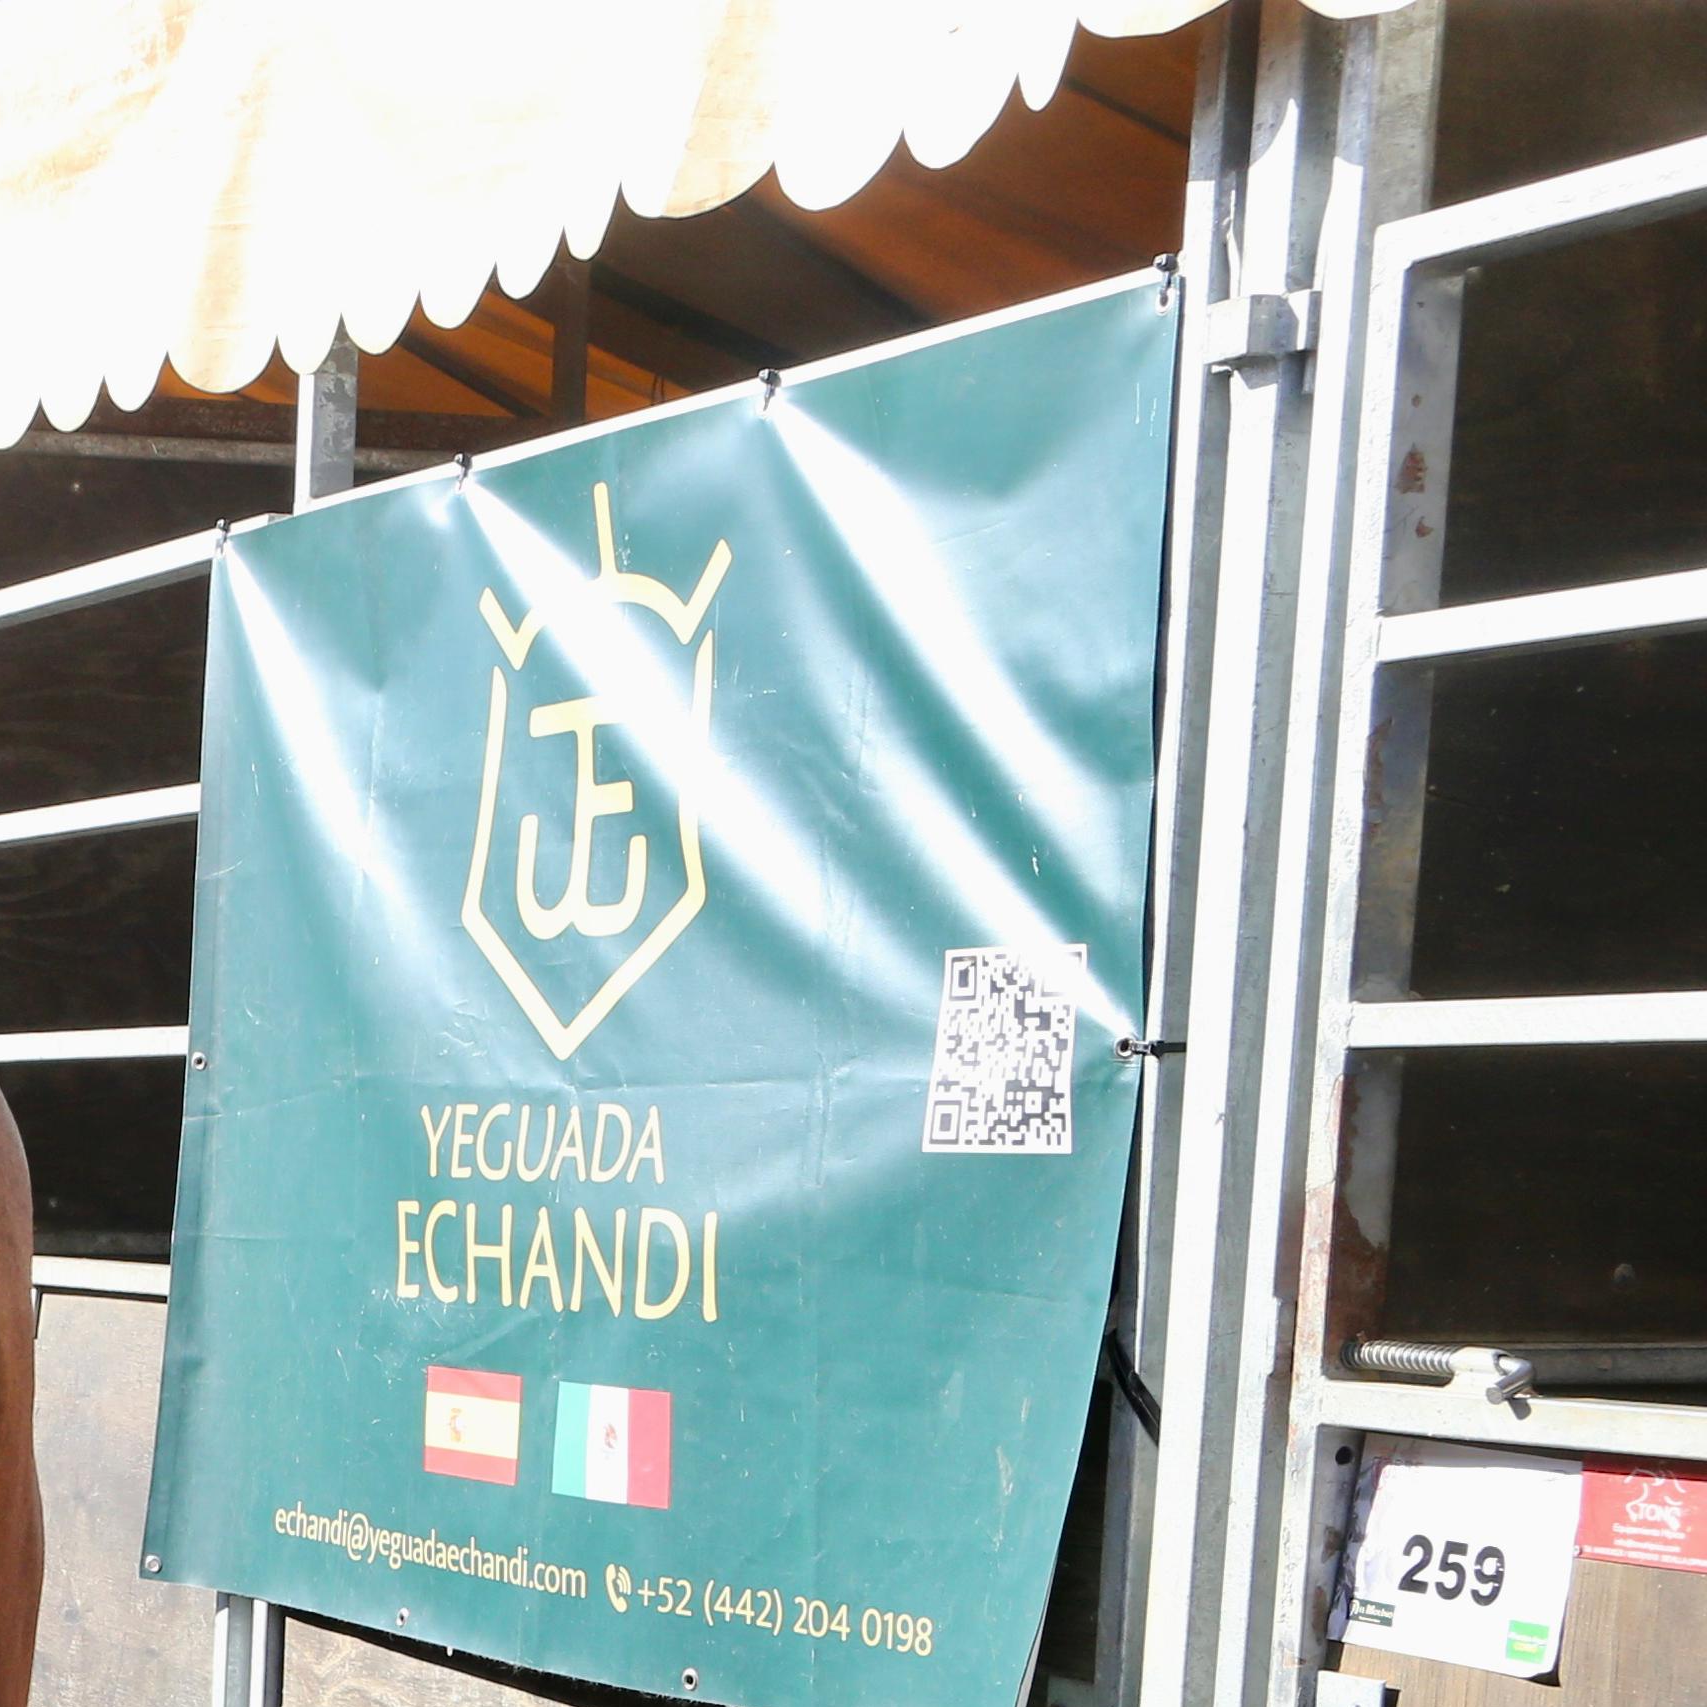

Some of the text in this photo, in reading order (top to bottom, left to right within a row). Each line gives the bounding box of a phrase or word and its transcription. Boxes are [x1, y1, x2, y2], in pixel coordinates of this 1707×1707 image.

[419, 1102, 665, 1184] YEGUADA
[395, 1199, 719, 1323] ECHANDI
[274, 1500, 934, 1658] echandi@yeguadaechandi.com +52 (442) 204 0198
[1397, 1533, 1506, 1607] 259
